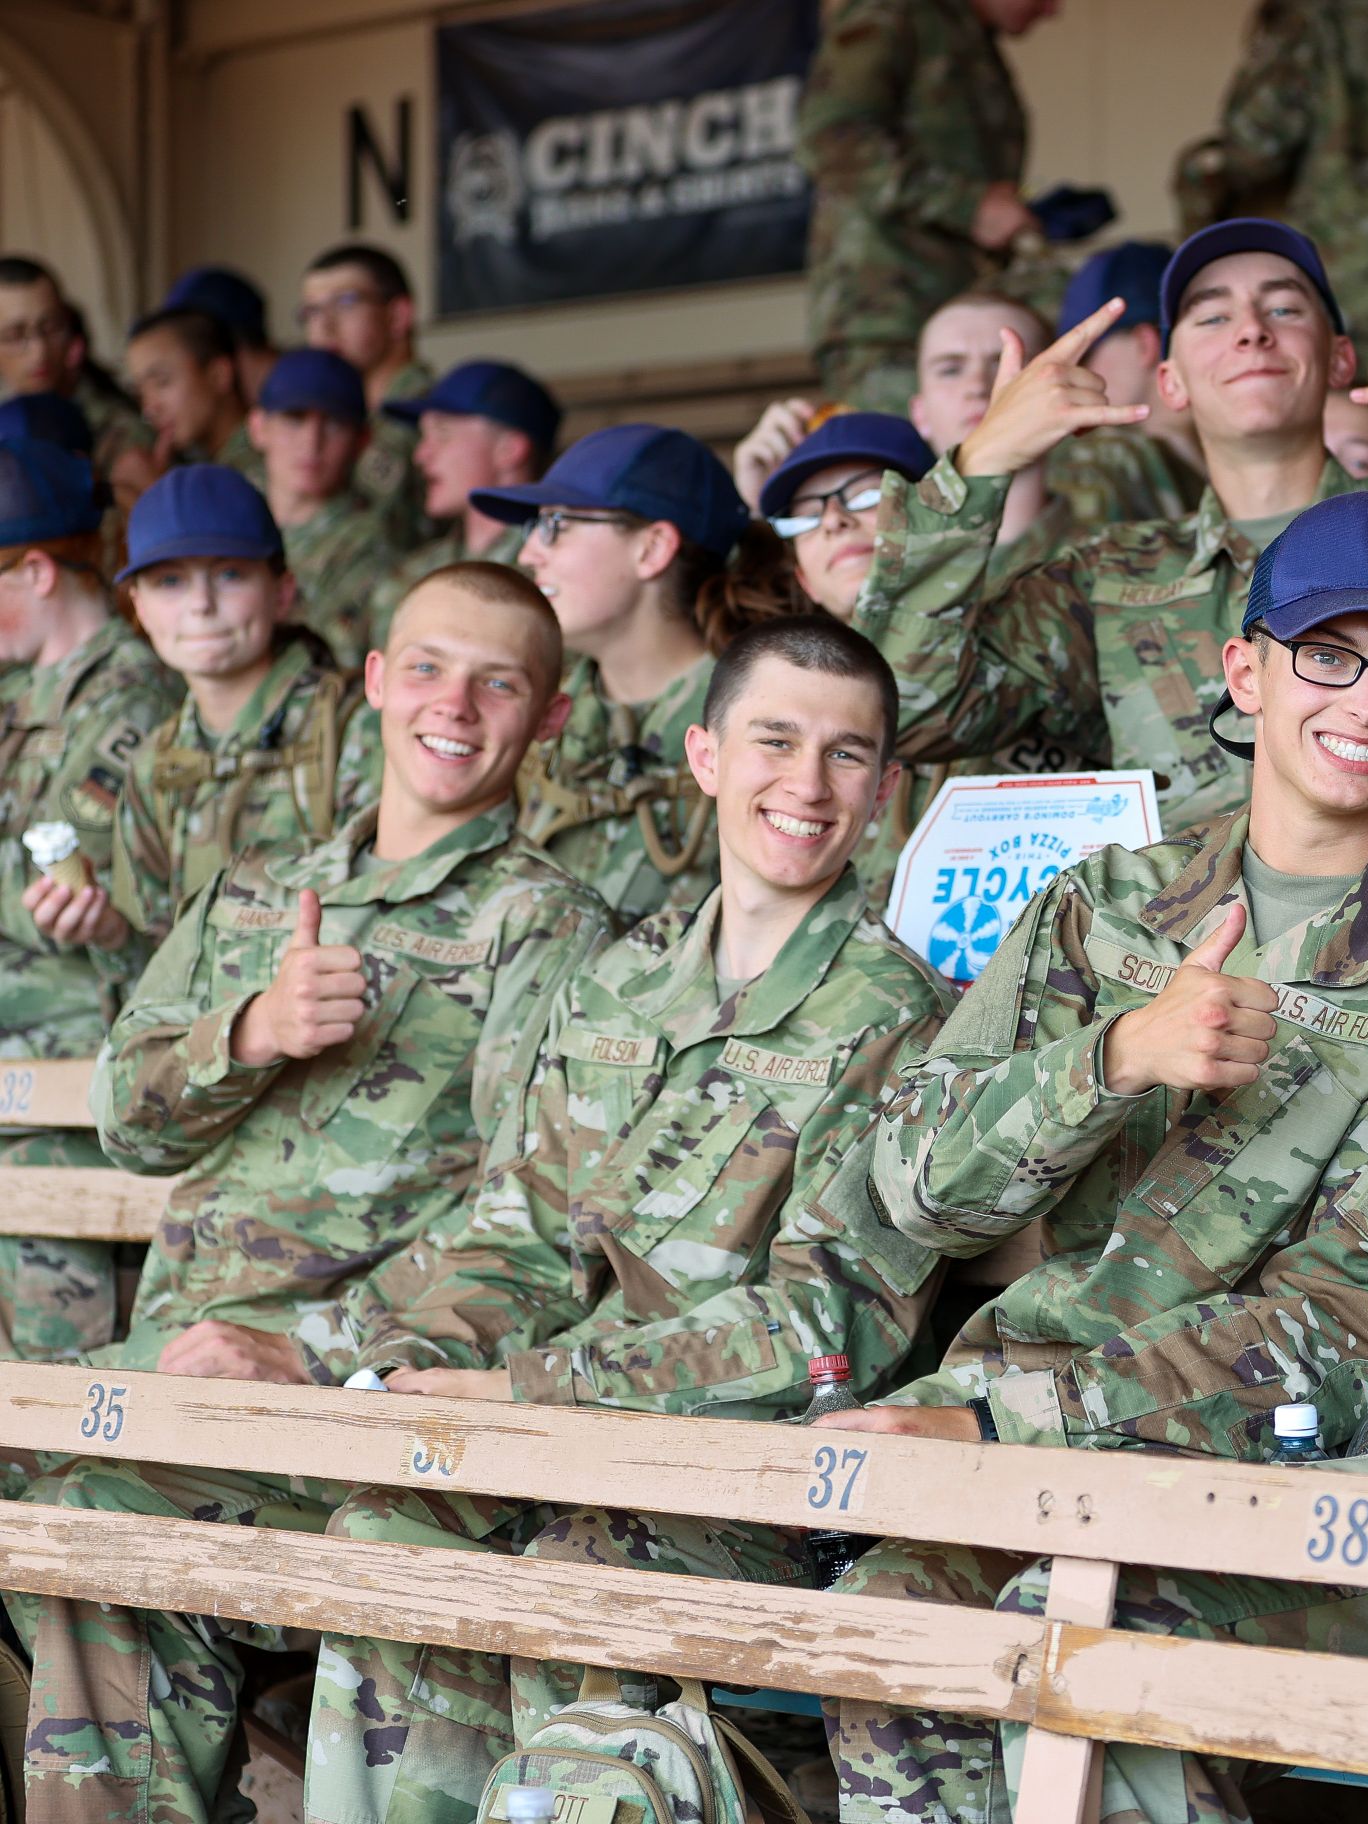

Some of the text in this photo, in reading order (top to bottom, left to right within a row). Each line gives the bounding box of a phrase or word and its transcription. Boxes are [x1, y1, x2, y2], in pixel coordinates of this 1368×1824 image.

[525, 75, 799, 191] CINCH
[350, 92, 412, 233] N
[988, 834, 1022, 862] BOX
[1031, 832, 1073, 859] PIZZA
[932, 865, 1064, 904] CYCLE
[1313, 1006, 1349, 1036] AIR
[723, 1046, 832, 1083] U.S. AIR FORCE
[0, 1071, 33, 1114] 32
[81, 1383, 127, 1442] 35
[807, 1446, 868, 1511] 37
